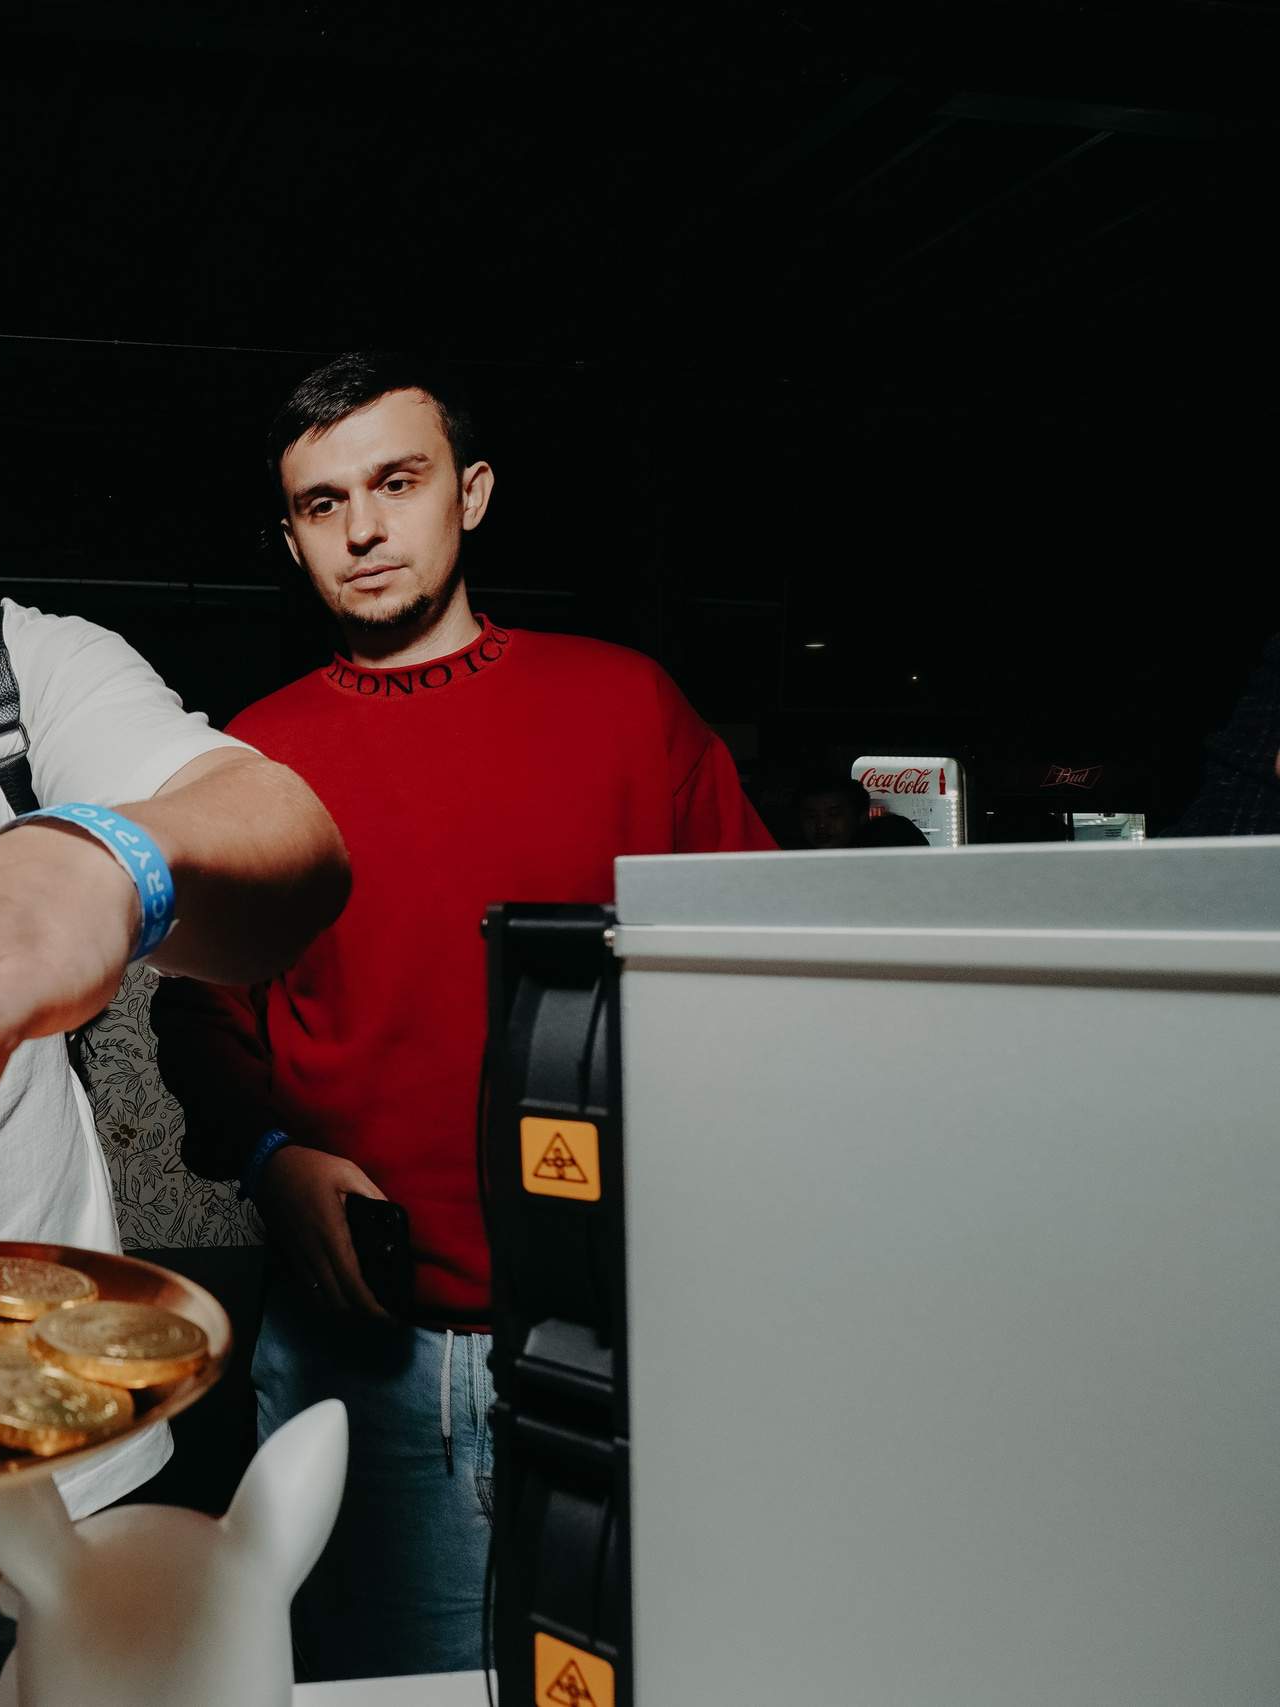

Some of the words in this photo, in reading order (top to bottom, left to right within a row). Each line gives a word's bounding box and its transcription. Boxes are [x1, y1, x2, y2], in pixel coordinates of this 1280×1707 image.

[860, 767, 934, 795] Coca-Cola
[1053, 767, 1089, 783] Bud
[71, 807, 168, 919] CRYPTO
